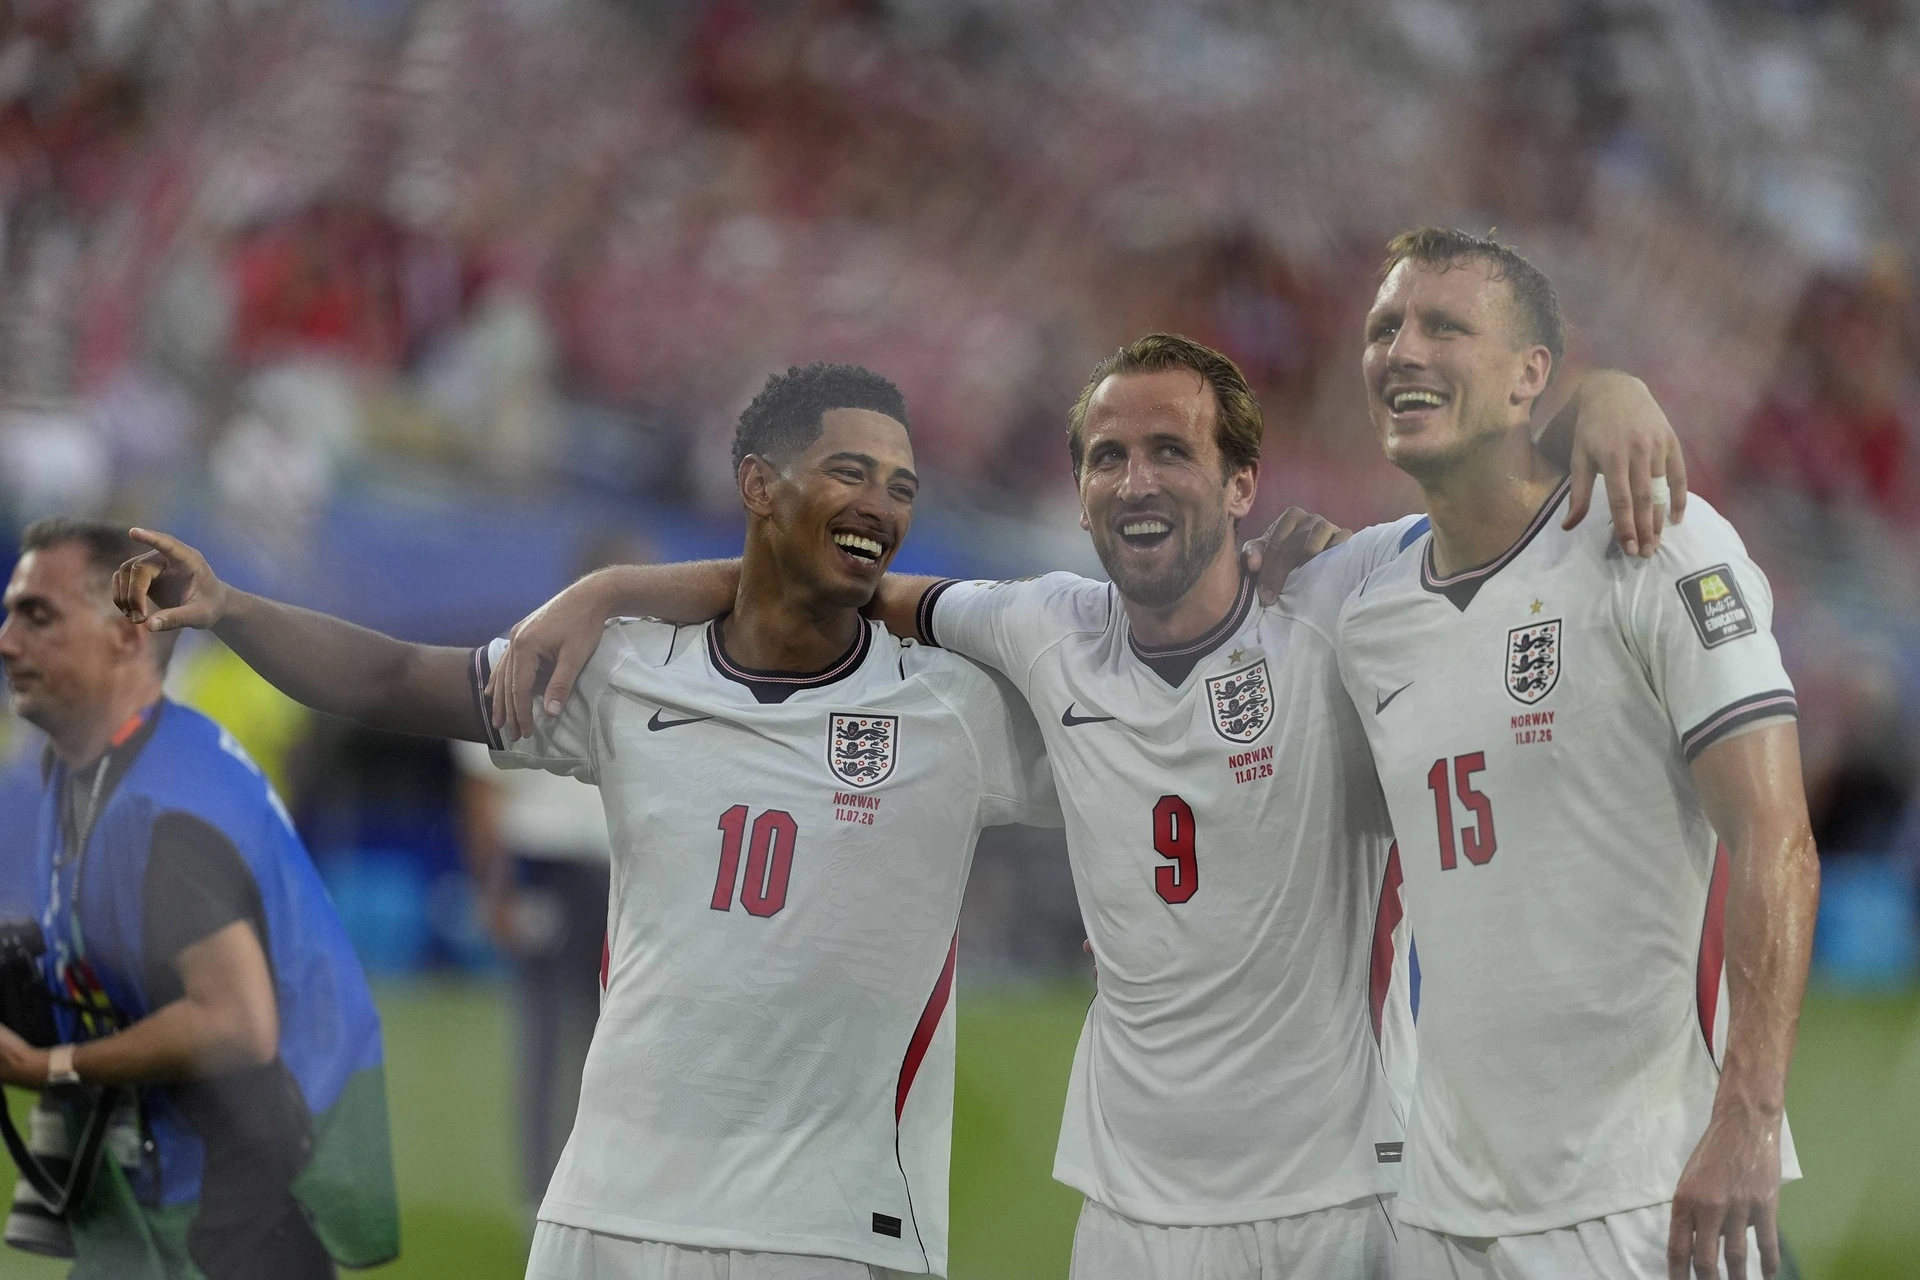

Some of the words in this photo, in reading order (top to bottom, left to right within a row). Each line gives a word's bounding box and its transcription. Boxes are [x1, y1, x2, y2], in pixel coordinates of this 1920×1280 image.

[1705, 607, 1747, 632] EDUCATION
[1722, 624, 1739, 635] FIFA
[1511, 711, 1555, 729] NORWAY
[1515, 729, 1553, 745] 11.07.26
[1228, 745, 1275, 769] NORWAY
[1235, 764, 1274, 785] 11.07.26
[833, 791, 881, 811] NORWAY
[1427, 750, 1498, 871] 15
[835, 808, 875, 826] 11.07.26
[1152, 794, 1199, 905] 9
[710, 804, 799, 919] 10
